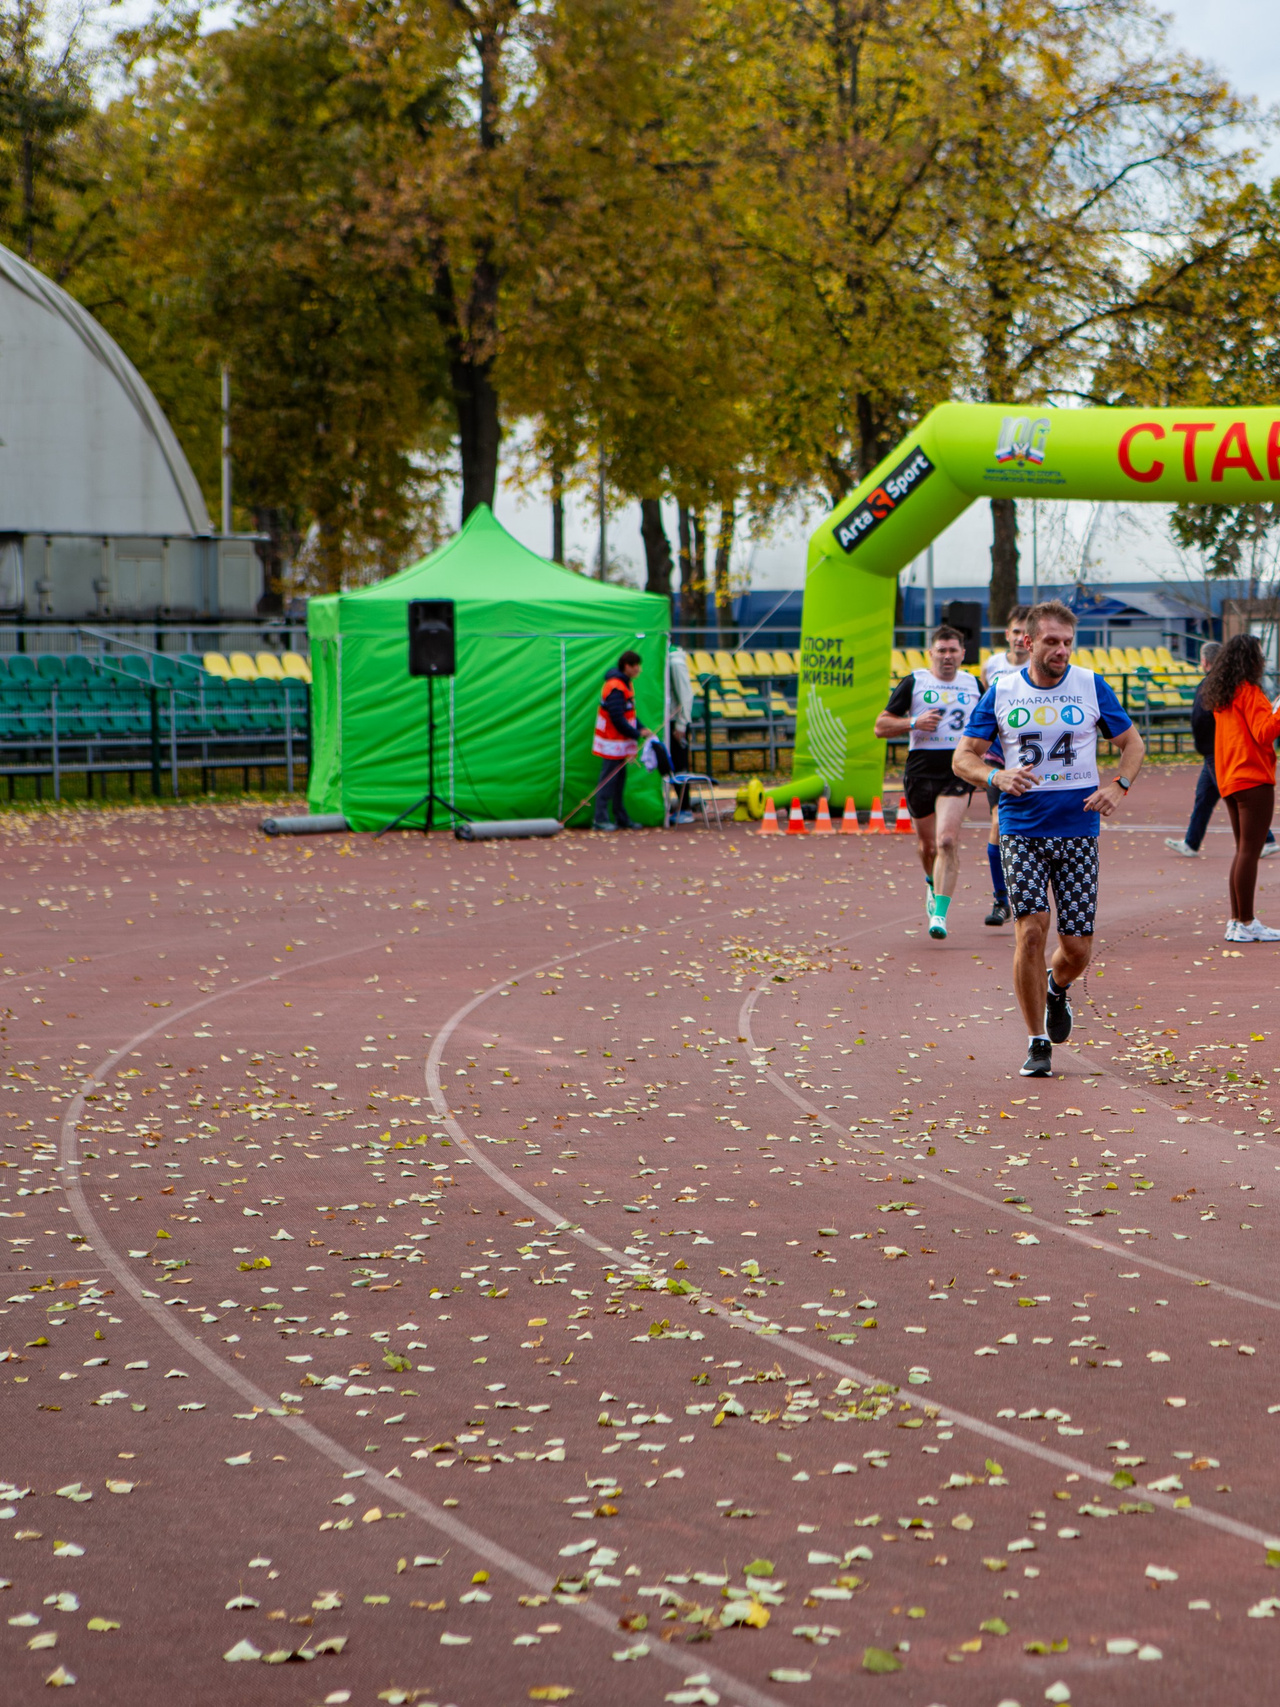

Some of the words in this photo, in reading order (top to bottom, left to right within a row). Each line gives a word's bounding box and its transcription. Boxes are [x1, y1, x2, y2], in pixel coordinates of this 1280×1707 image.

[839, 510, 874, 547] Arta
[885, 453, 929, 500] Sport
[804, 636, 844, 653] СПОРТ
[803, 653, 854, 671] НОРМА
[802, 670, 854, 688] ЖИЗНИ
[1008, 695, 1083, 706] VMARAFONE
[1018, 731, 1078, 769] 54
